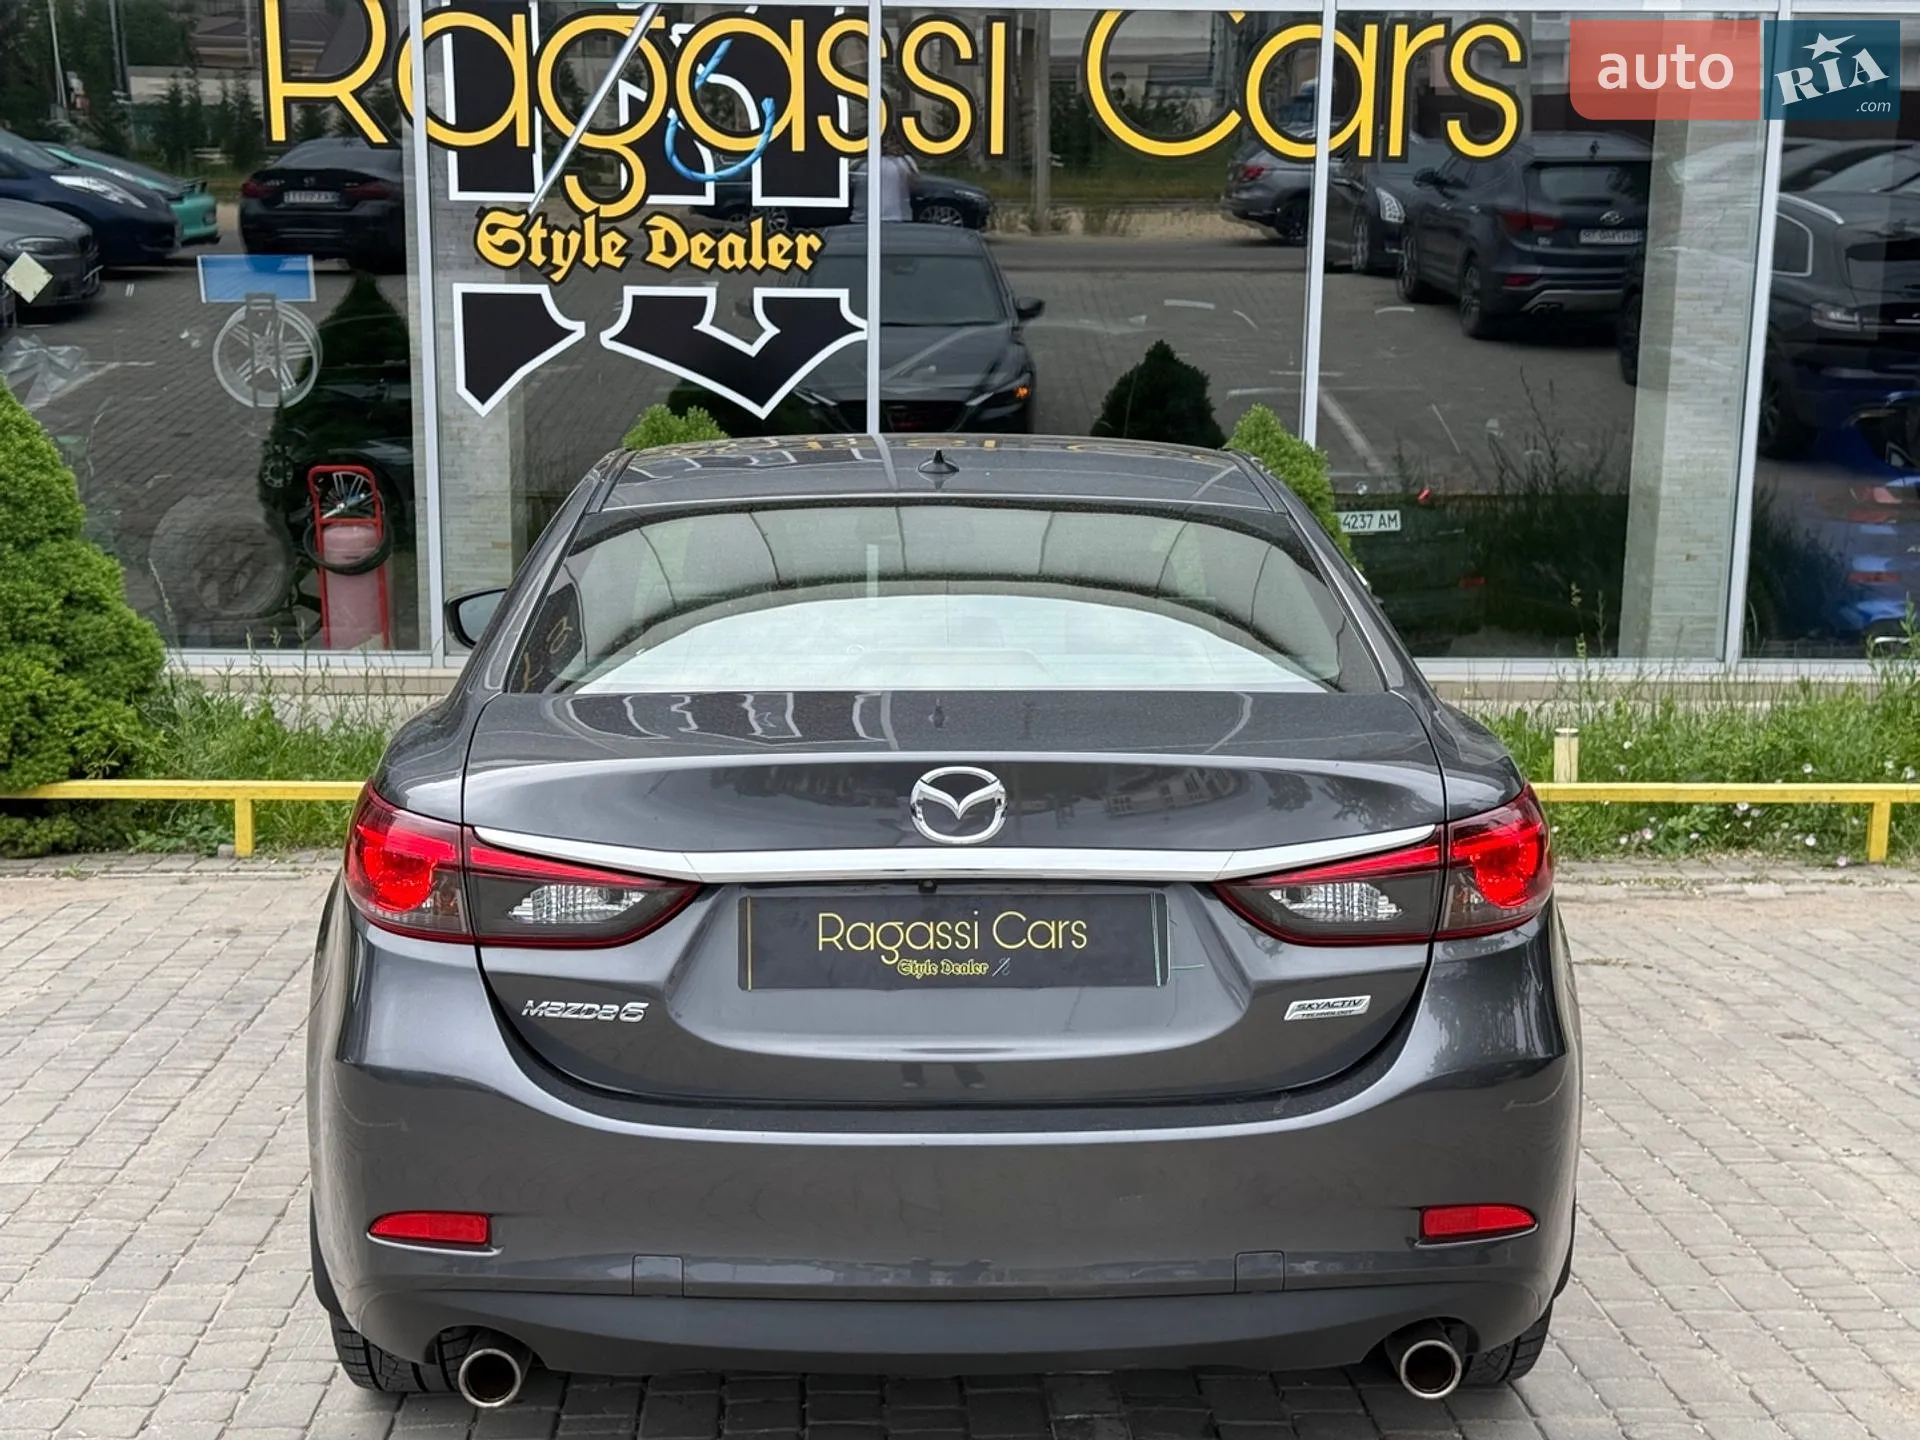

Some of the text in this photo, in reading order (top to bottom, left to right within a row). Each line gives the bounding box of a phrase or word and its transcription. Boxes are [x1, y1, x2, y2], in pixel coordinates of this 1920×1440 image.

[263, 0, 1524, 219] Ragassi Cars
[476, 209, 822, 283] Style Dealer
[1342, 513, 1373, 529] 4237
[817, 909, 1087, 964] Ragassi Cars
[898, 959, 989, 979] Style Dealer
[1296, 999, 1363, 1010] SKYACTIV
